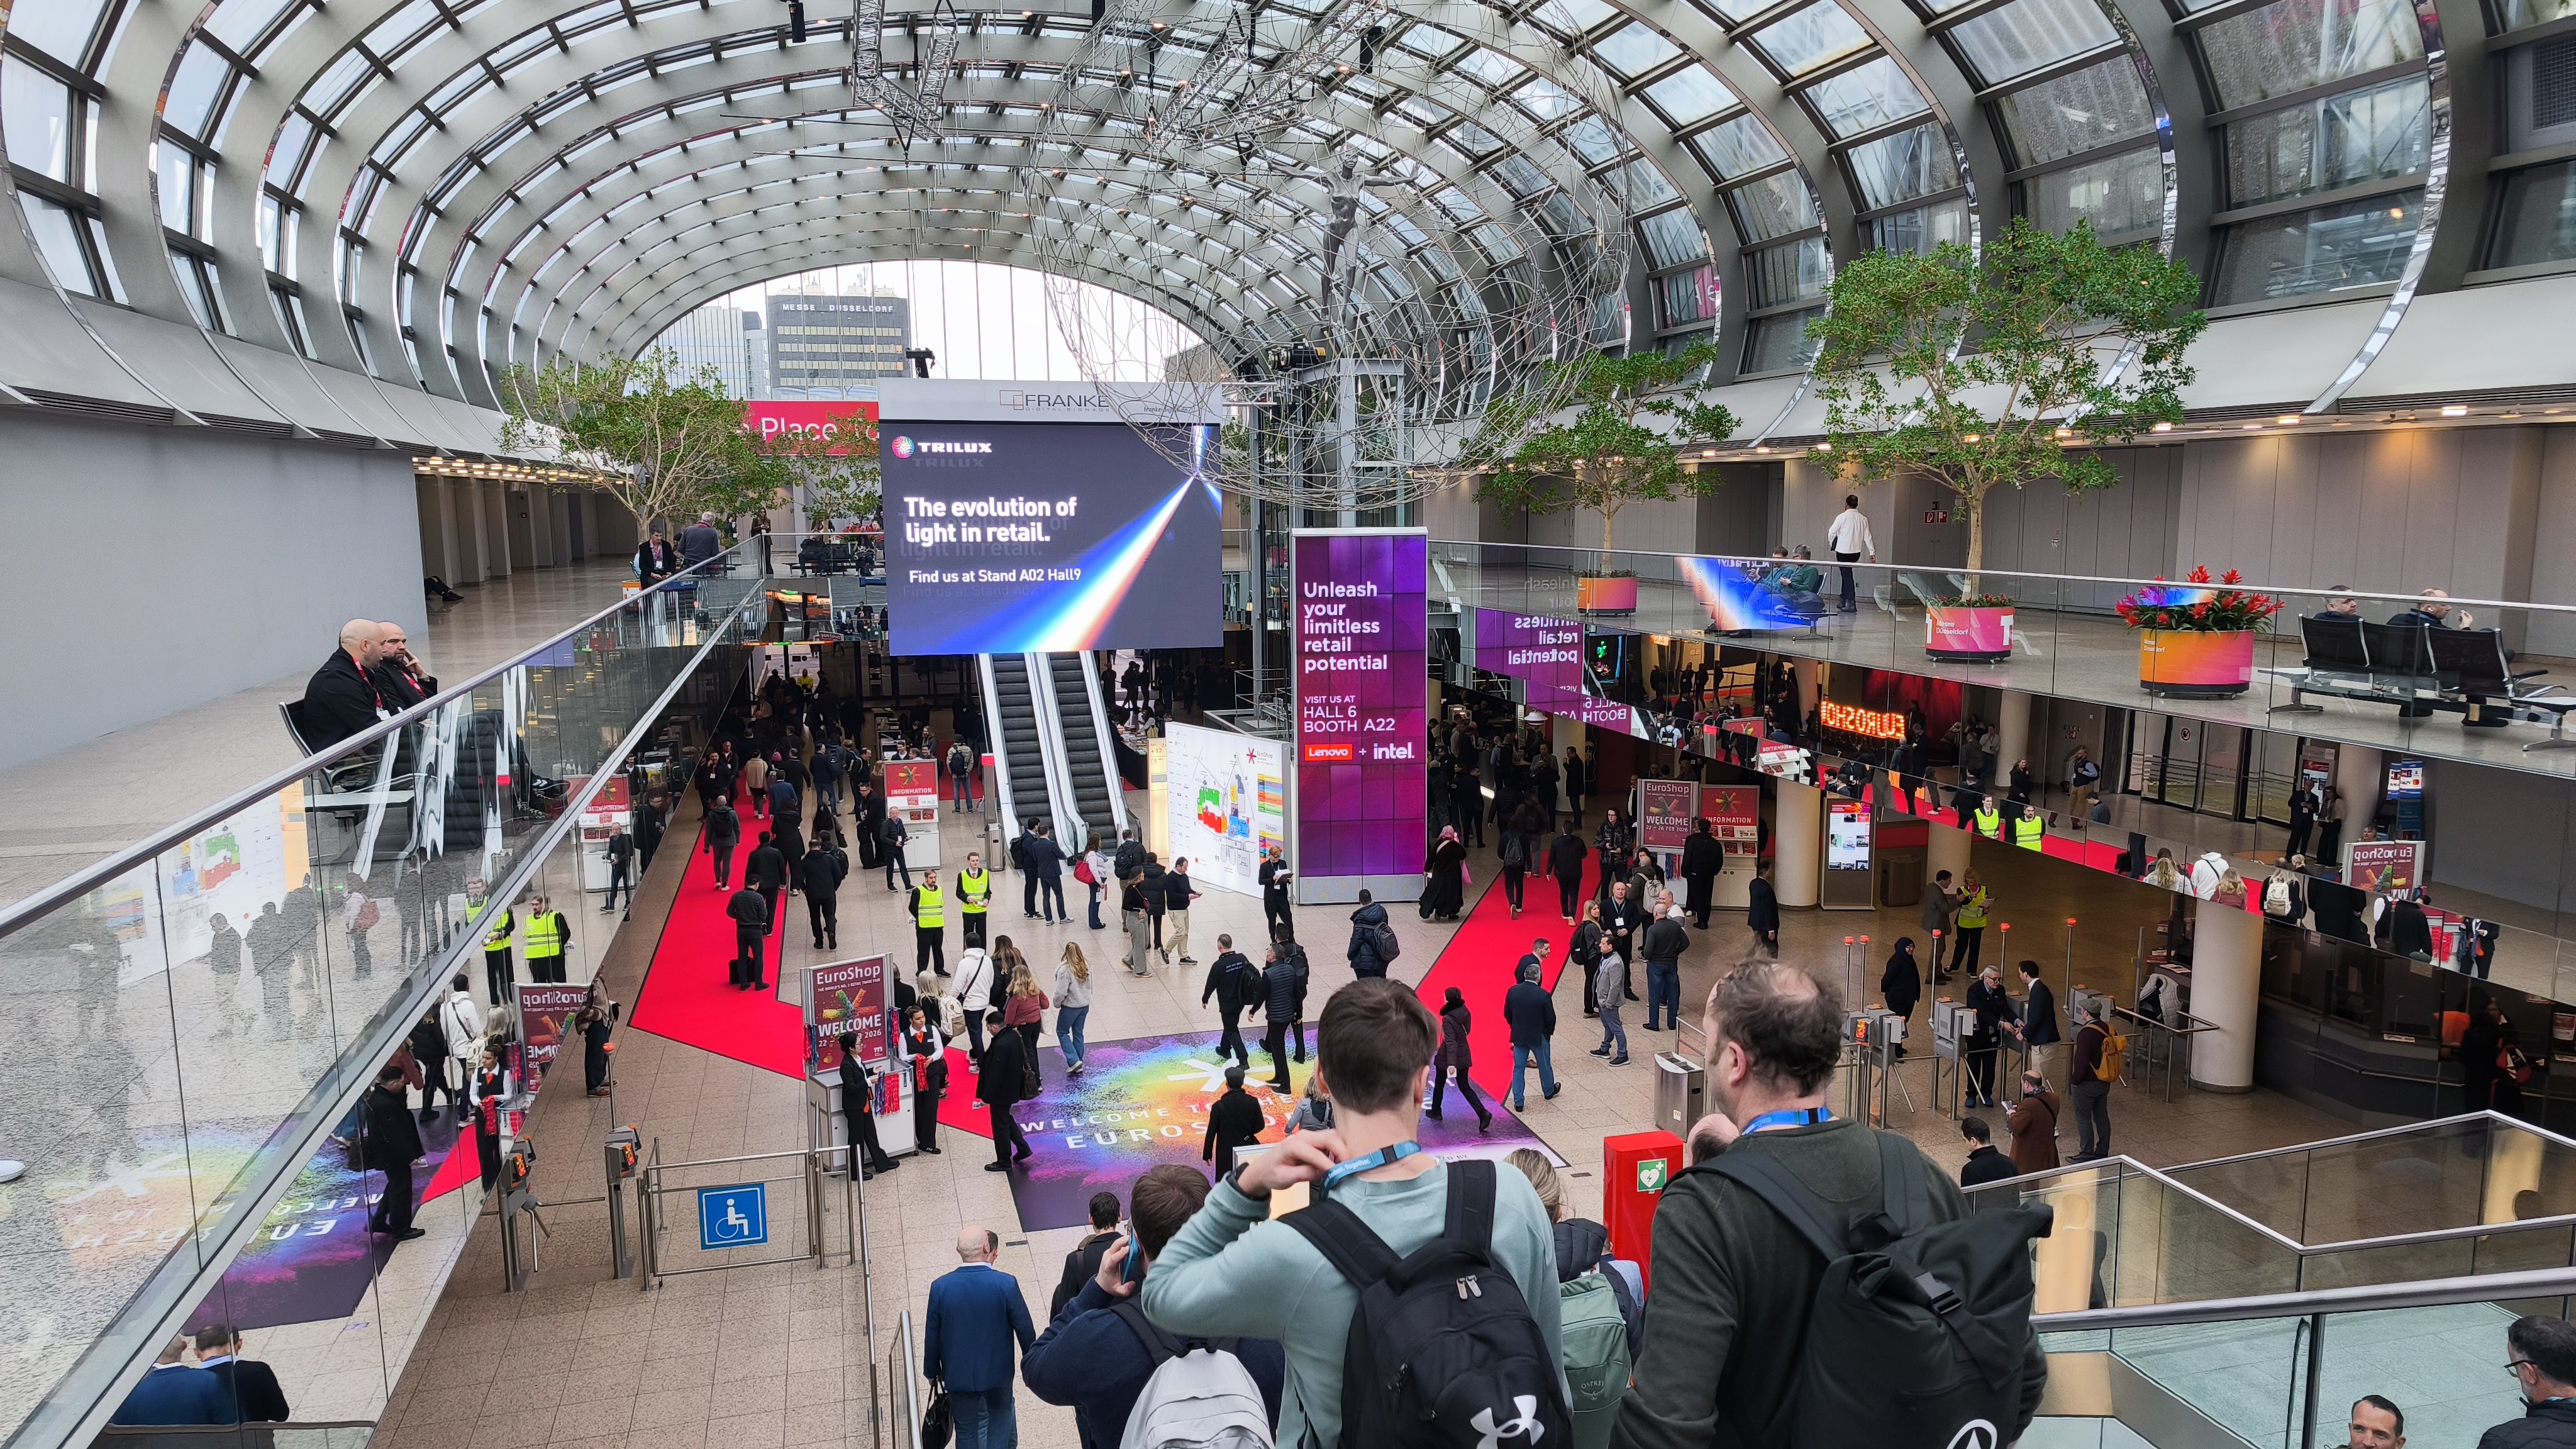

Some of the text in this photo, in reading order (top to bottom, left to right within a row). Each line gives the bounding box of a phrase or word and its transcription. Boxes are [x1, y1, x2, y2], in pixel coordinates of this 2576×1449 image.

[1026, 394, 1109, 408] FRANKE
[761, 417, 838, 441] Place
[917, 442, 992, 453] TRILUX
[903, 496, 1077, 517] The evolution of
[906, 522, 1050, 547] light in retail.
[909, 568, 1081, 583] Find us at Stand A02 Hall9
[1304, 581, 1378, 597] Unleash
[1304, 603, 1346, 619] your
[1304, 618, 1380, 634] limitless
[1304, 636, 1352, 652] retail
[1304, 655, 1388, 674] potential
[1304, 695, 1356, 704] VISIT US AT
[1304, 705, 1357, 718] HALL 6
[1304, 718, 1396, 733] BOOTH A22
[1309, 747, 1348, 757] Lenovo
[891, 787, 932, 795] INFORMATION
[1646, 783, 1689, 794] EuroShop
[1646, 816, 1689, 826] WELCOME
[816, 965, 880, 985] EuroShop
[818, 1014, 882, 1037] WELCOME
[864, 1029, 882, 1038] 2026
[1019, 1108, 1171, 1132] WELCOME
